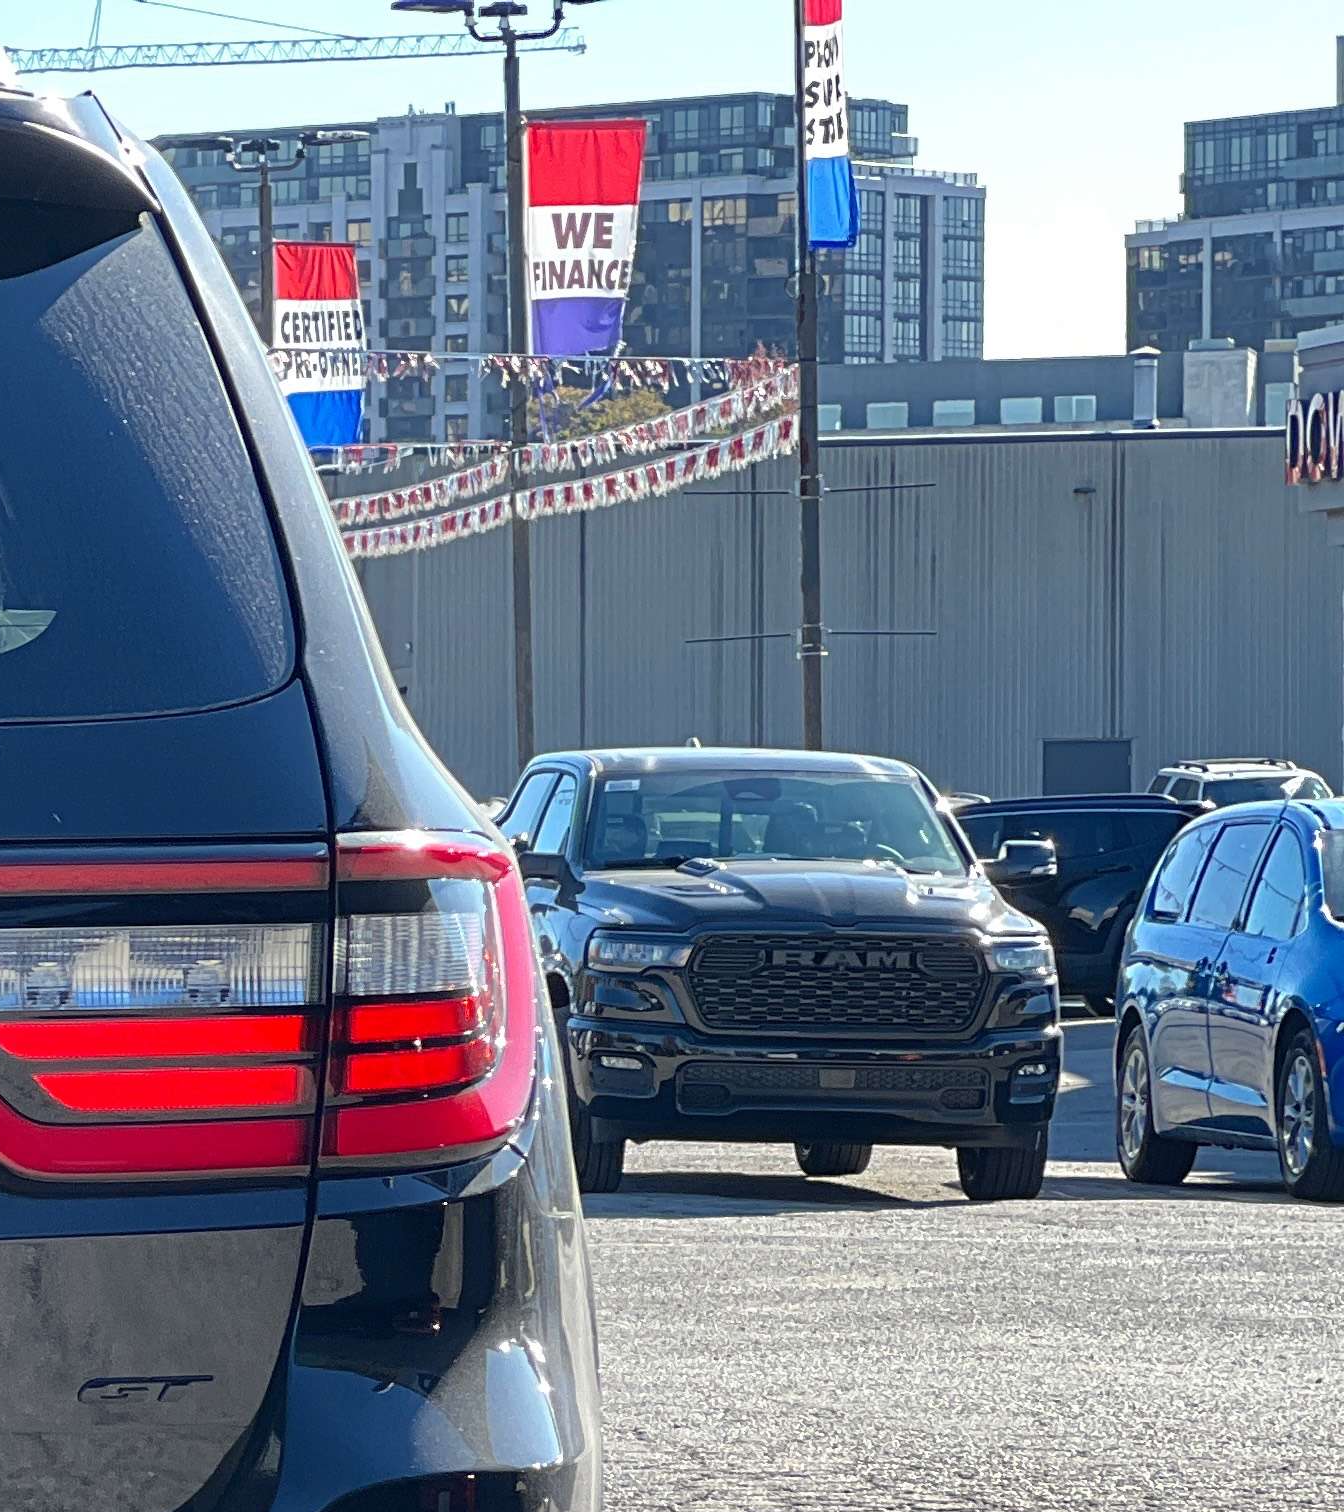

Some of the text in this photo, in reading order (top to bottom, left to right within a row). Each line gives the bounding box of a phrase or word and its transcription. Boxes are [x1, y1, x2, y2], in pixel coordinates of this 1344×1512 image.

[552, 212, 614, 249] WE
[533, 259, 631, 291] FINANCE
[280, 310, 362, 343] CERTIFIED
[772, 950, 912, 969] RAM
[77, 1375, 214, 1402] GT
